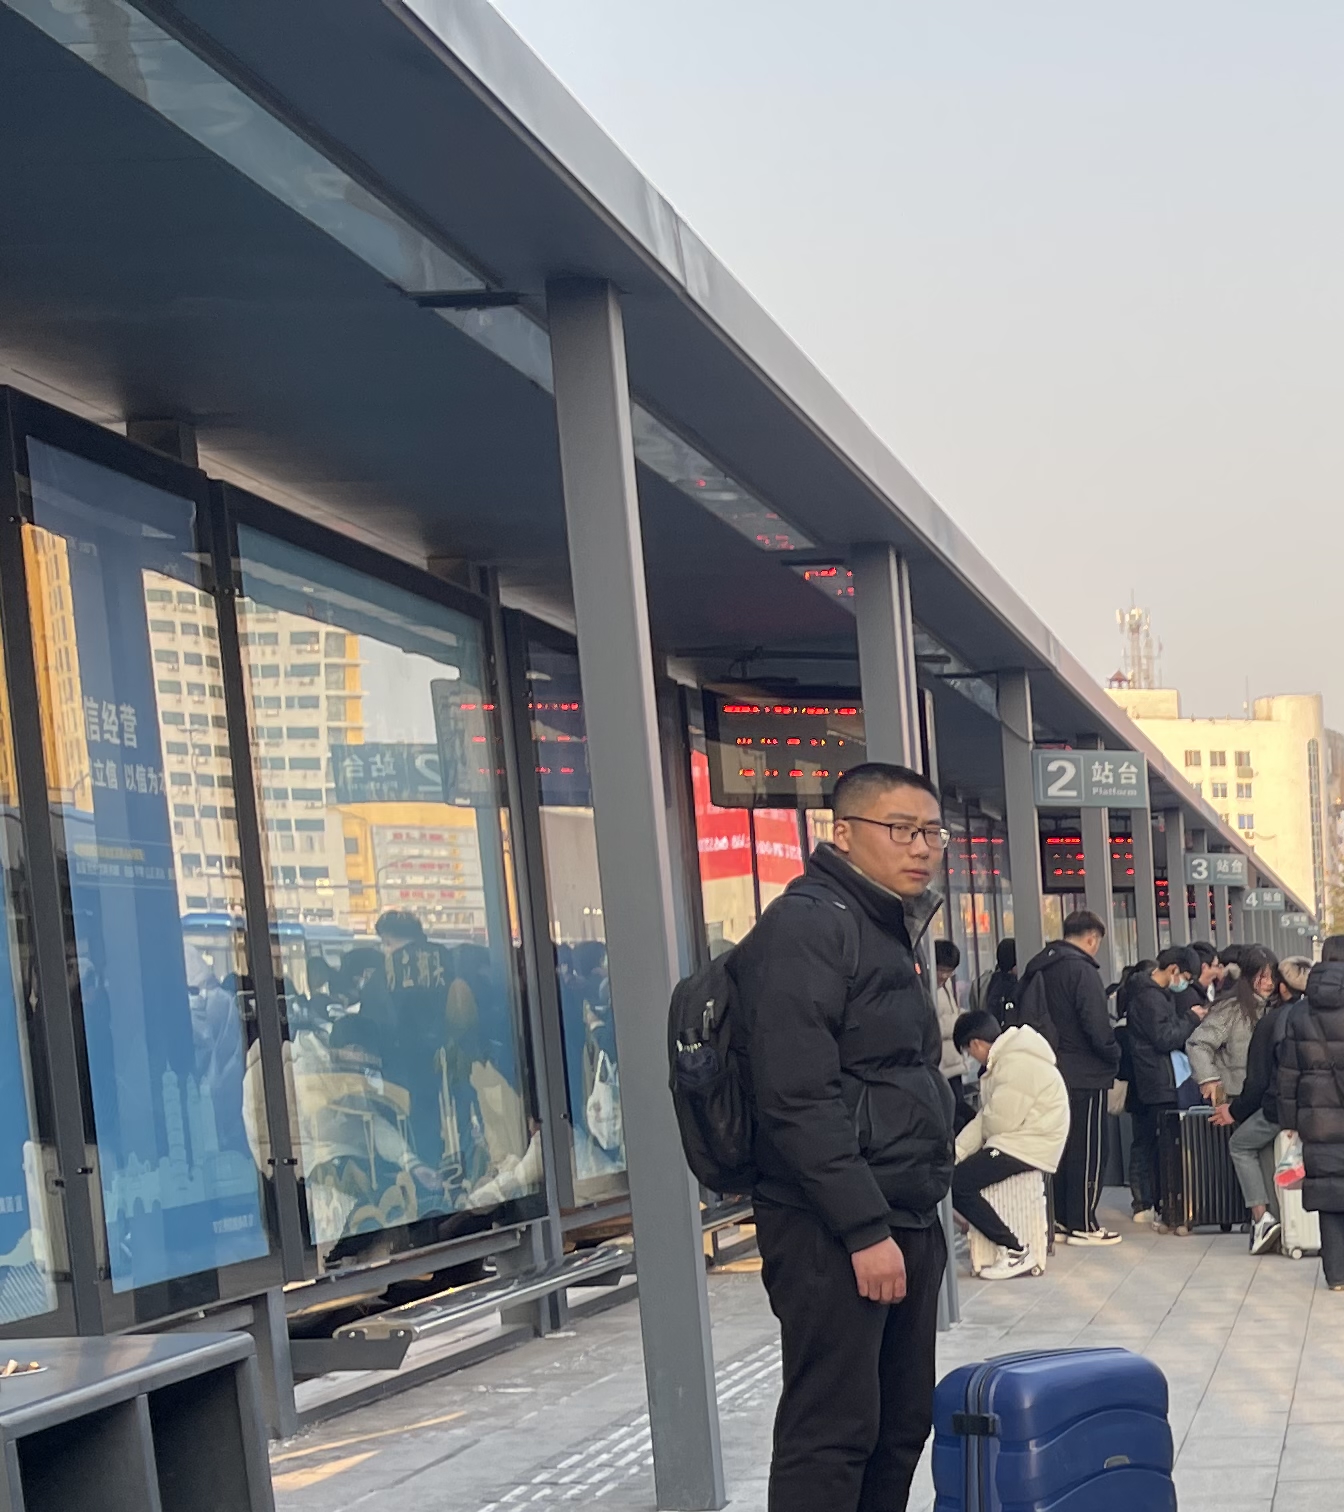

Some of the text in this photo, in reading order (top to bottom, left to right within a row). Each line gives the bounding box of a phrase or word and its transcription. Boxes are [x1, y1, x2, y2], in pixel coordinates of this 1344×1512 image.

[89, 758, 118, 790] 立信
[1047, 759, 1138, 797] 2 站台
[1092, 786, 1137, 795] Platform
[1191, 858, 1243, 880] 3 站台
[1245, 891, 1259, 907] 4
